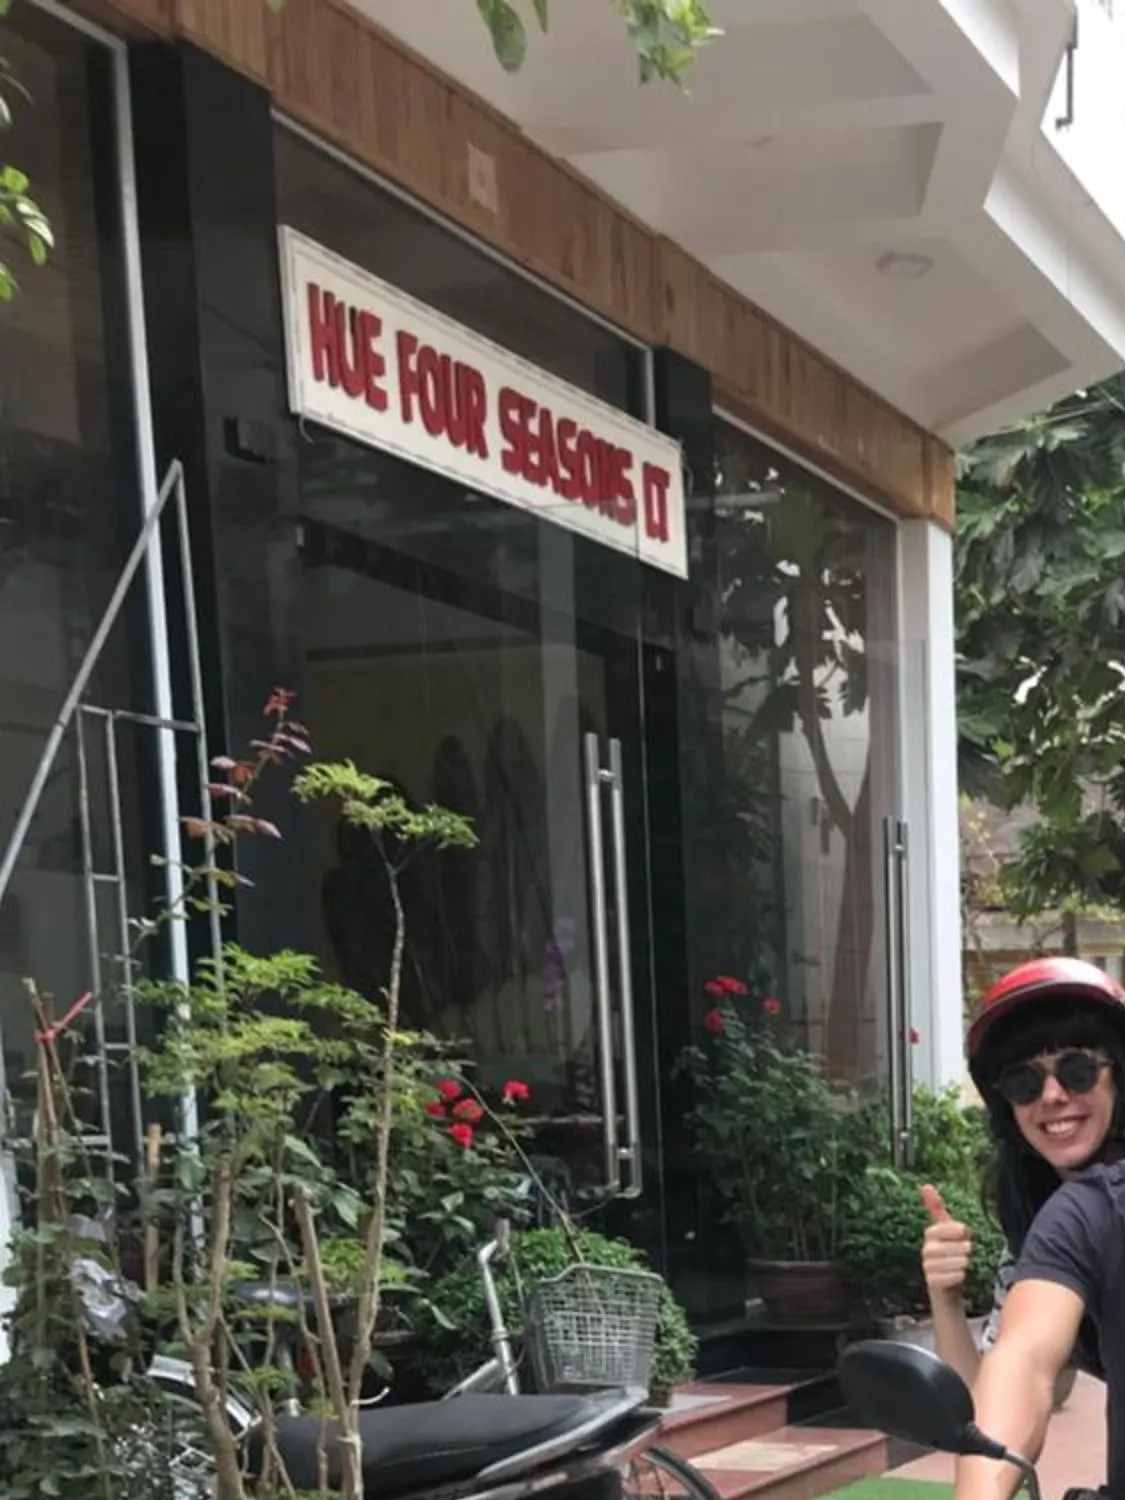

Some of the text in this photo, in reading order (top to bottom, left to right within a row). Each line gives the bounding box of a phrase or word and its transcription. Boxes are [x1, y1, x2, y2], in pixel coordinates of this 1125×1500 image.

[307, 283, 388, 412] HUE
[396, 330, 489, 460] FOUR
[499, 387, 638, 527] SEASONS
